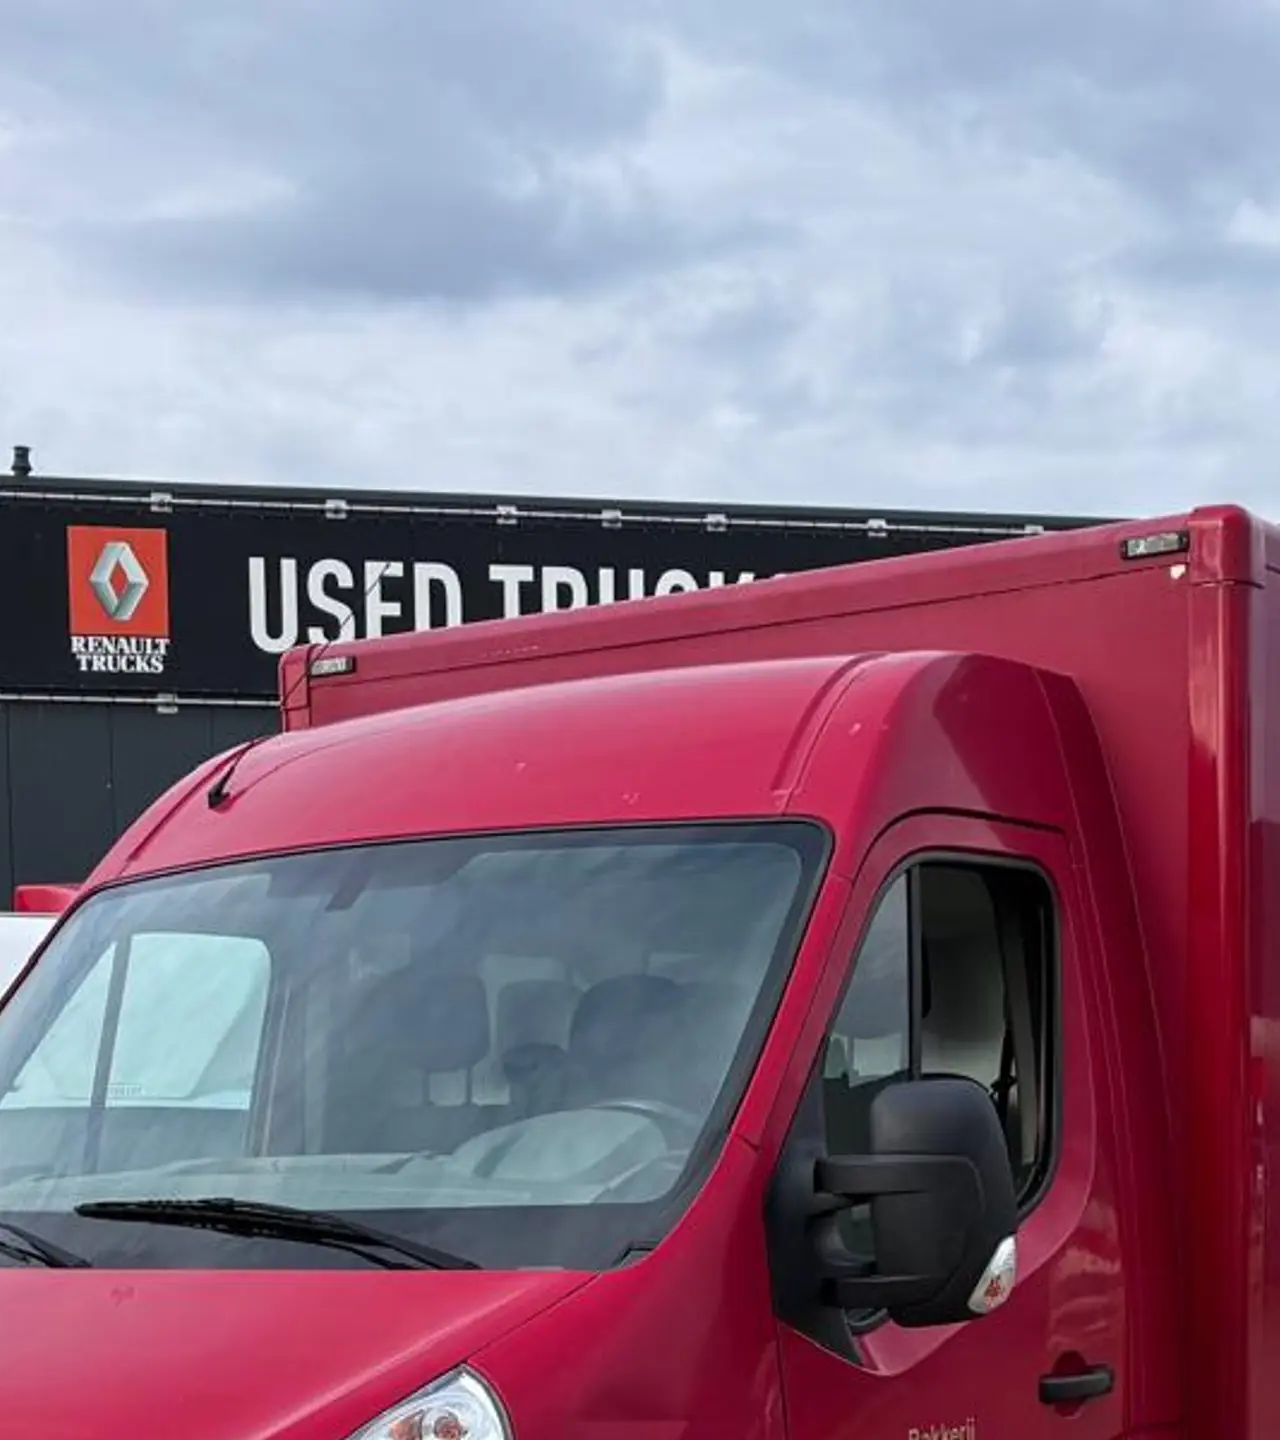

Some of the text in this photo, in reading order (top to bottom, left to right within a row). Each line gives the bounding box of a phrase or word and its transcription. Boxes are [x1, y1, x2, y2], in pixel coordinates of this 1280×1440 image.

[248, 556, 463, 655] USED
[70, 635, 171, 655] RENAULT
[76, 654, 165, 674] TRUCKS
